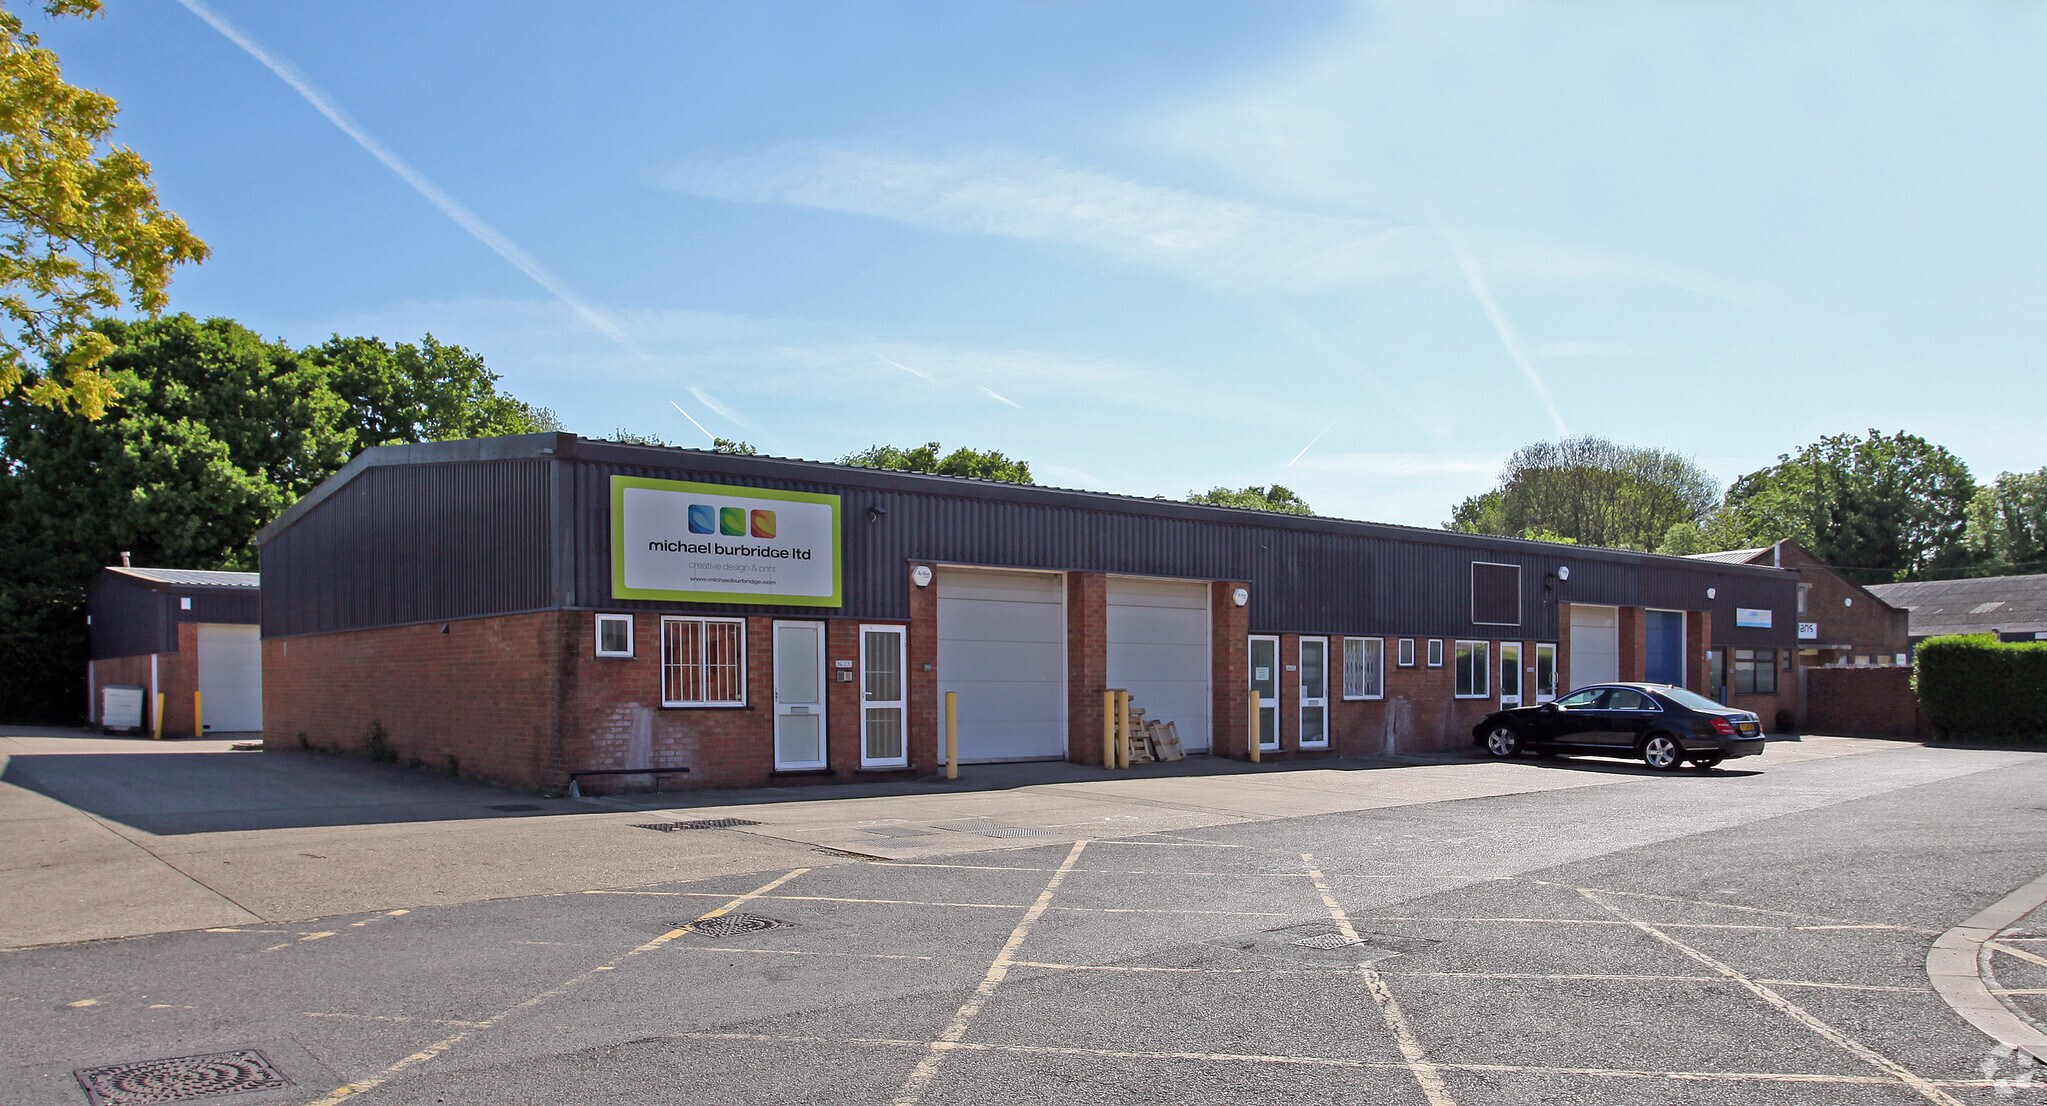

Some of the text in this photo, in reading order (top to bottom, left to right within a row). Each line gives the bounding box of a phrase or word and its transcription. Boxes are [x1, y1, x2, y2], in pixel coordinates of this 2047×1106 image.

[649, 540, 811, 560] michael burbridge ltd
[688, 561, 722, 571] creative
[723, 563, 750, 573] design
[751, 564, 758, 572] &
[689, 576, 777, 585] www.michaelburbridge.com
